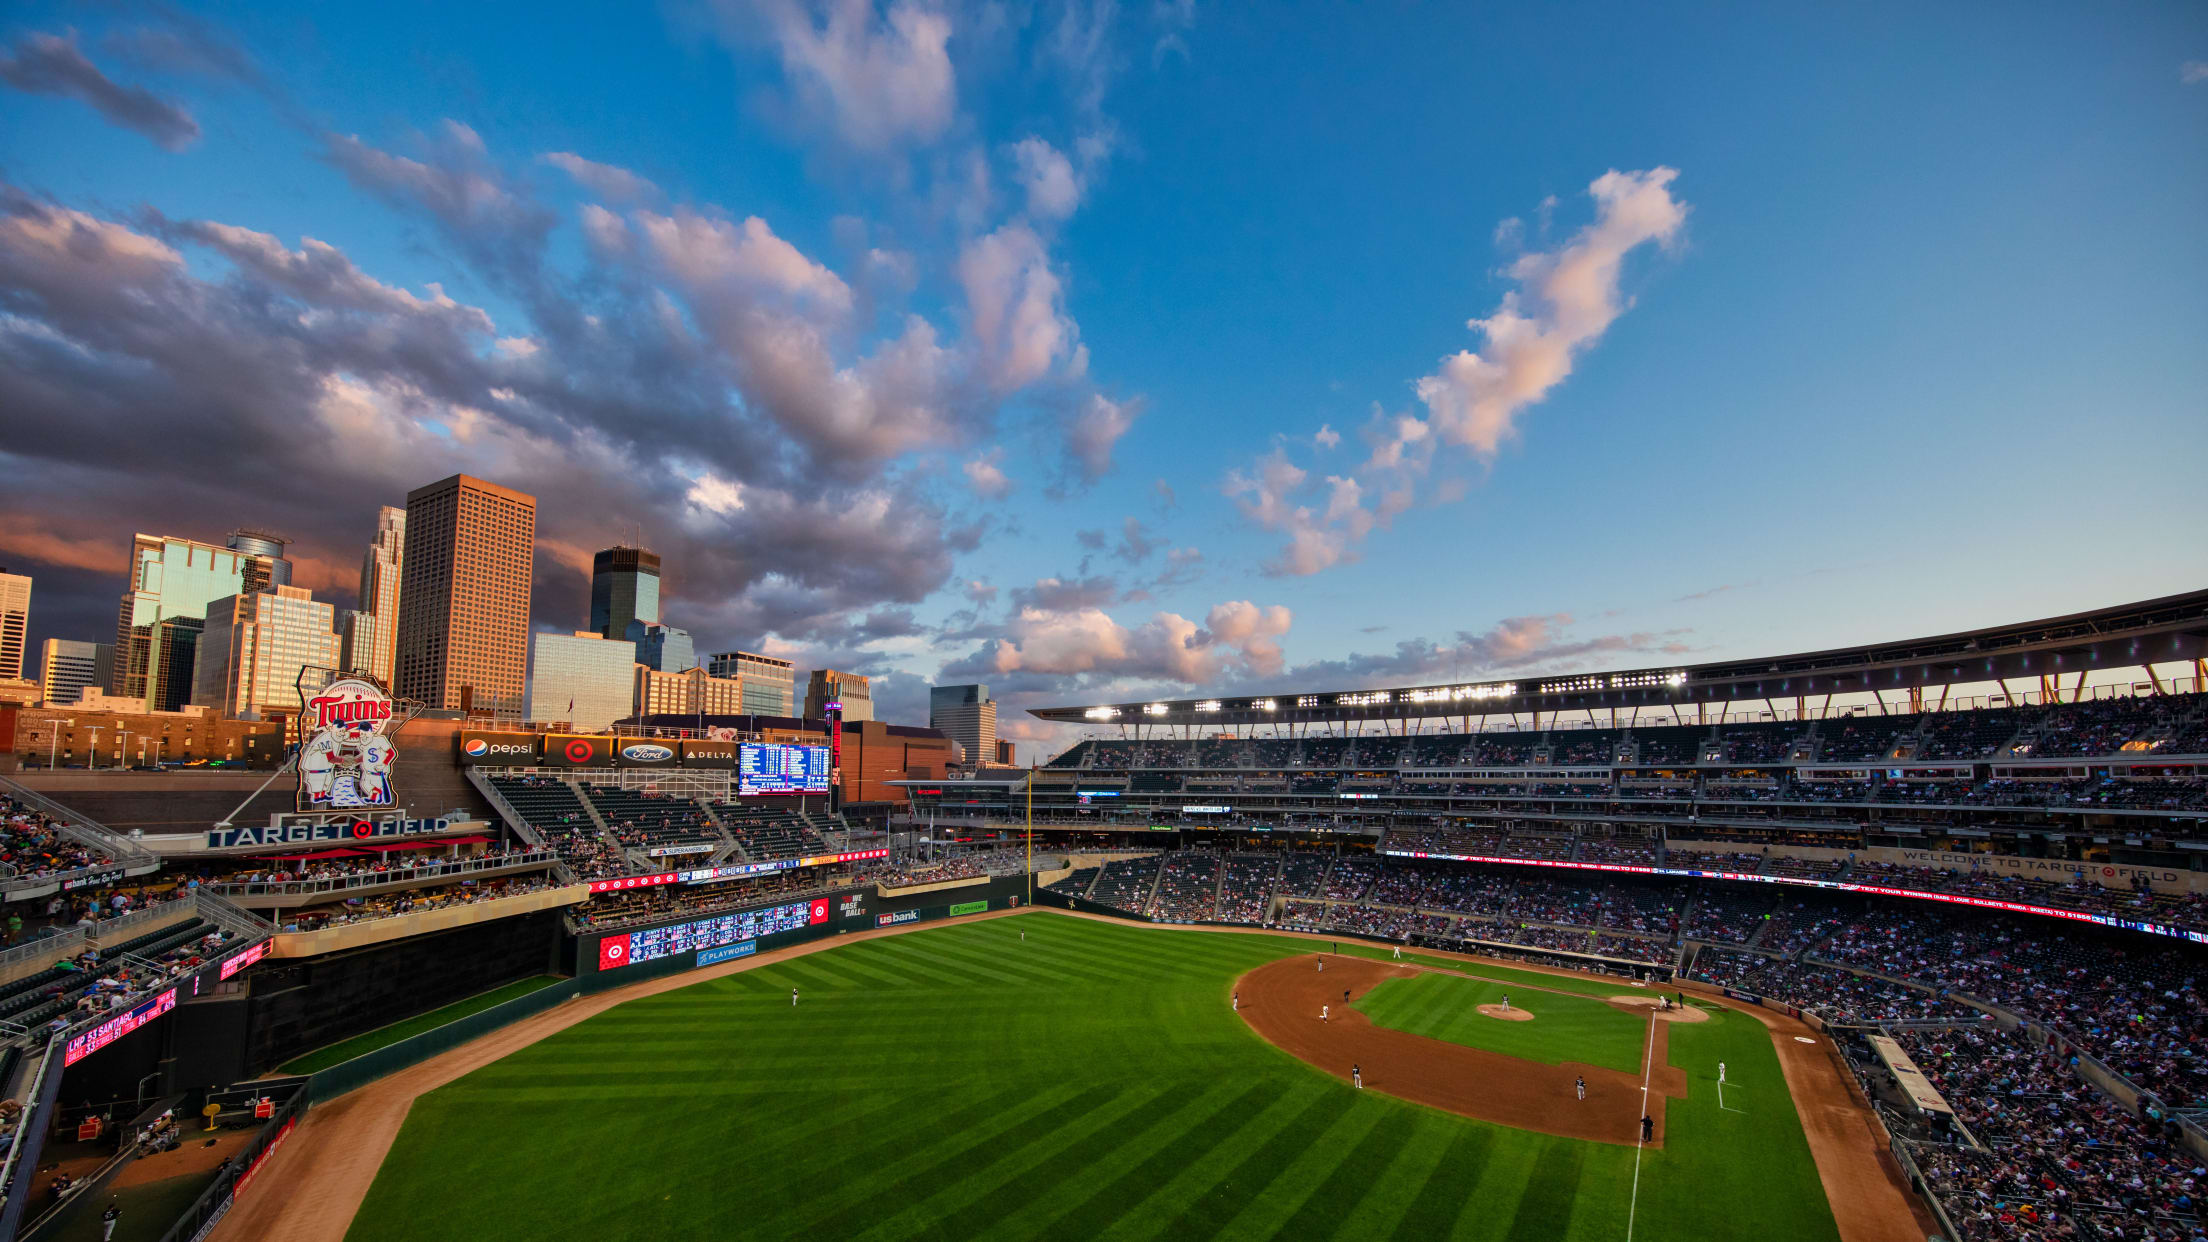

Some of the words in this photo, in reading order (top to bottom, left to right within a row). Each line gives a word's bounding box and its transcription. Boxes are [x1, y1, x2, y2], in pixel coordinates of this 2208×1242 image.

[309, 694, 391, 729] Twins
[321, 741, 331, 750] M
[490, 743, 532, 755] pepsi
[367, 748, 379, 763] S
[633, 747, 664, 760] Ford
[698, 751, 733, 759] DELTA
[210, 823, 349, 847] TARGET
[379, 818, 450, 836] FIELD
[669, 846, 708, 854] SUPERAMERICA
[1903, 851, 1991, 866] WELCOME
[1999, 859, 2021, 868] TO
[2026, 860, 2101, 875] TARGET
[2119, 868, 2178, 882] FIELD
[852, 894, 862, 902] WE
[1903, 890, 1932, 898] WINNER
[840, 902, 857, 911] BASE
[845, 908, 861, 917] BALL
[708, 944, 754, 960] PLAYWORKS
[138, 1013, 147, 1025] 84
[69, 1036, 85, 1052] LHP
[87, 1029, 97, 1043] 53
[98, 1011, 133, 1037] SANTIAGO
[68, 1048, 83, 1063] BALLS
[85, 1041, 96, 1055] 33
